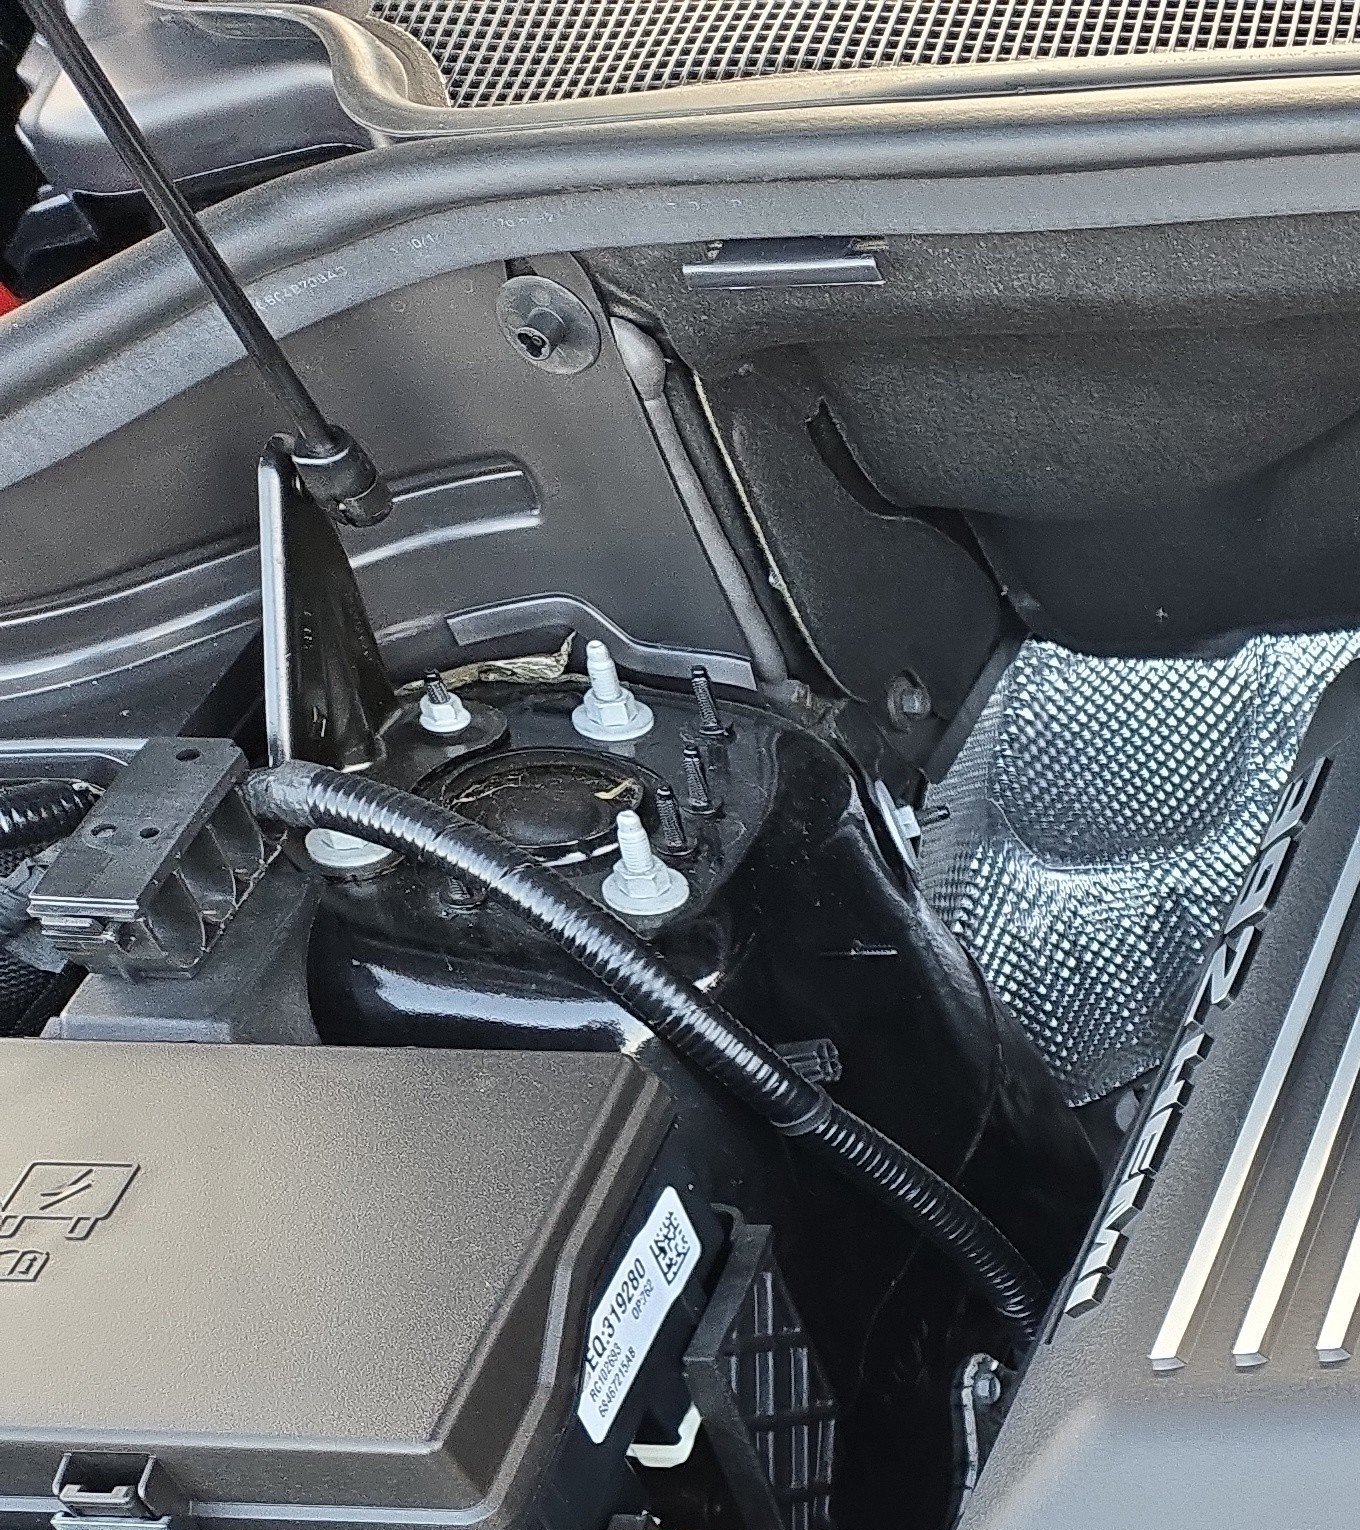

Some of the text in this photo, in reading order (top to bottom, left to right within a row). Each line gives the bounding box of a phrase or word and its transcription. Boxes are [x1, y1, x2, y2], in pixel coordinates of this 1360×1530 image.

[1064, 756, 1332, 1320] 392 HEMI
[585, 1257, 646, 1377] EQ:319280
